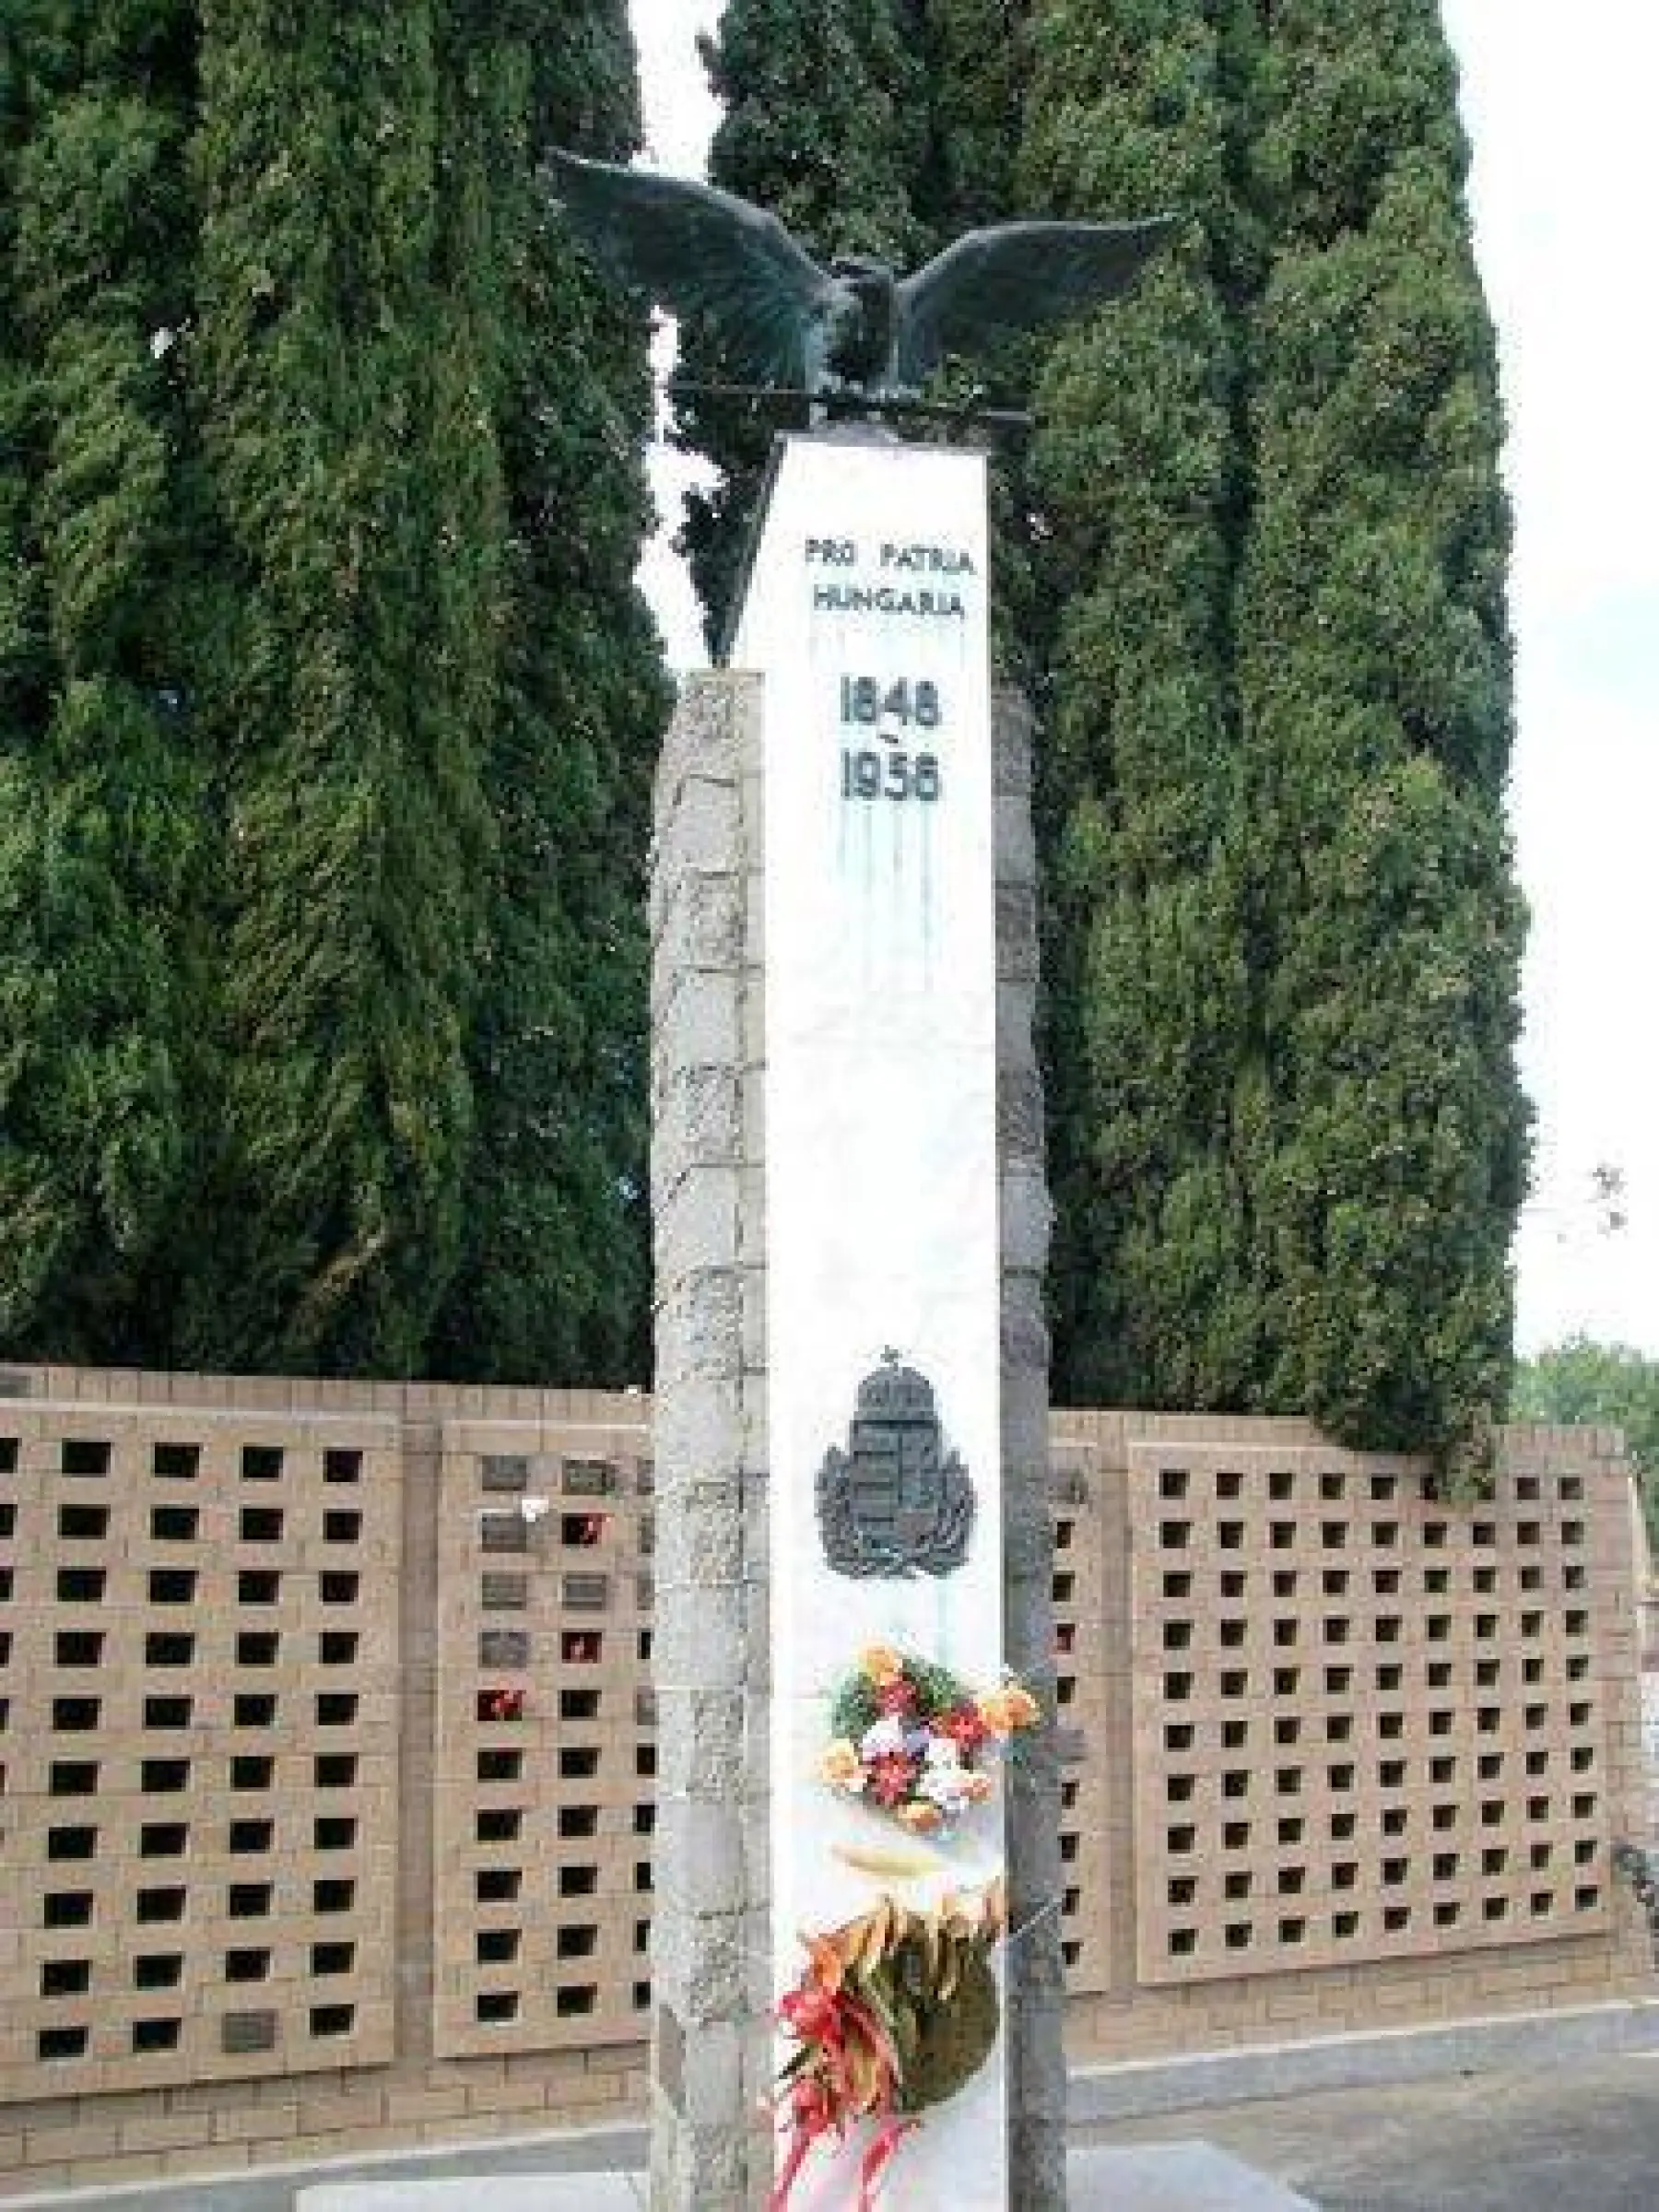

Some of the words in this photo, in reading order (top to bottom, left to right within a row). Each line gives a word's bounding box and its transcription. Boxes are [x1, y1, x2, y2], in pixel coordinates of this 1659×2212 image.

[805, 539, 856, 567] PRO
[880, 543, 975, 575] PATRIA
[813, 584, 965, 617] HUNGARIA
[841, 676, 941, 728] 1848
